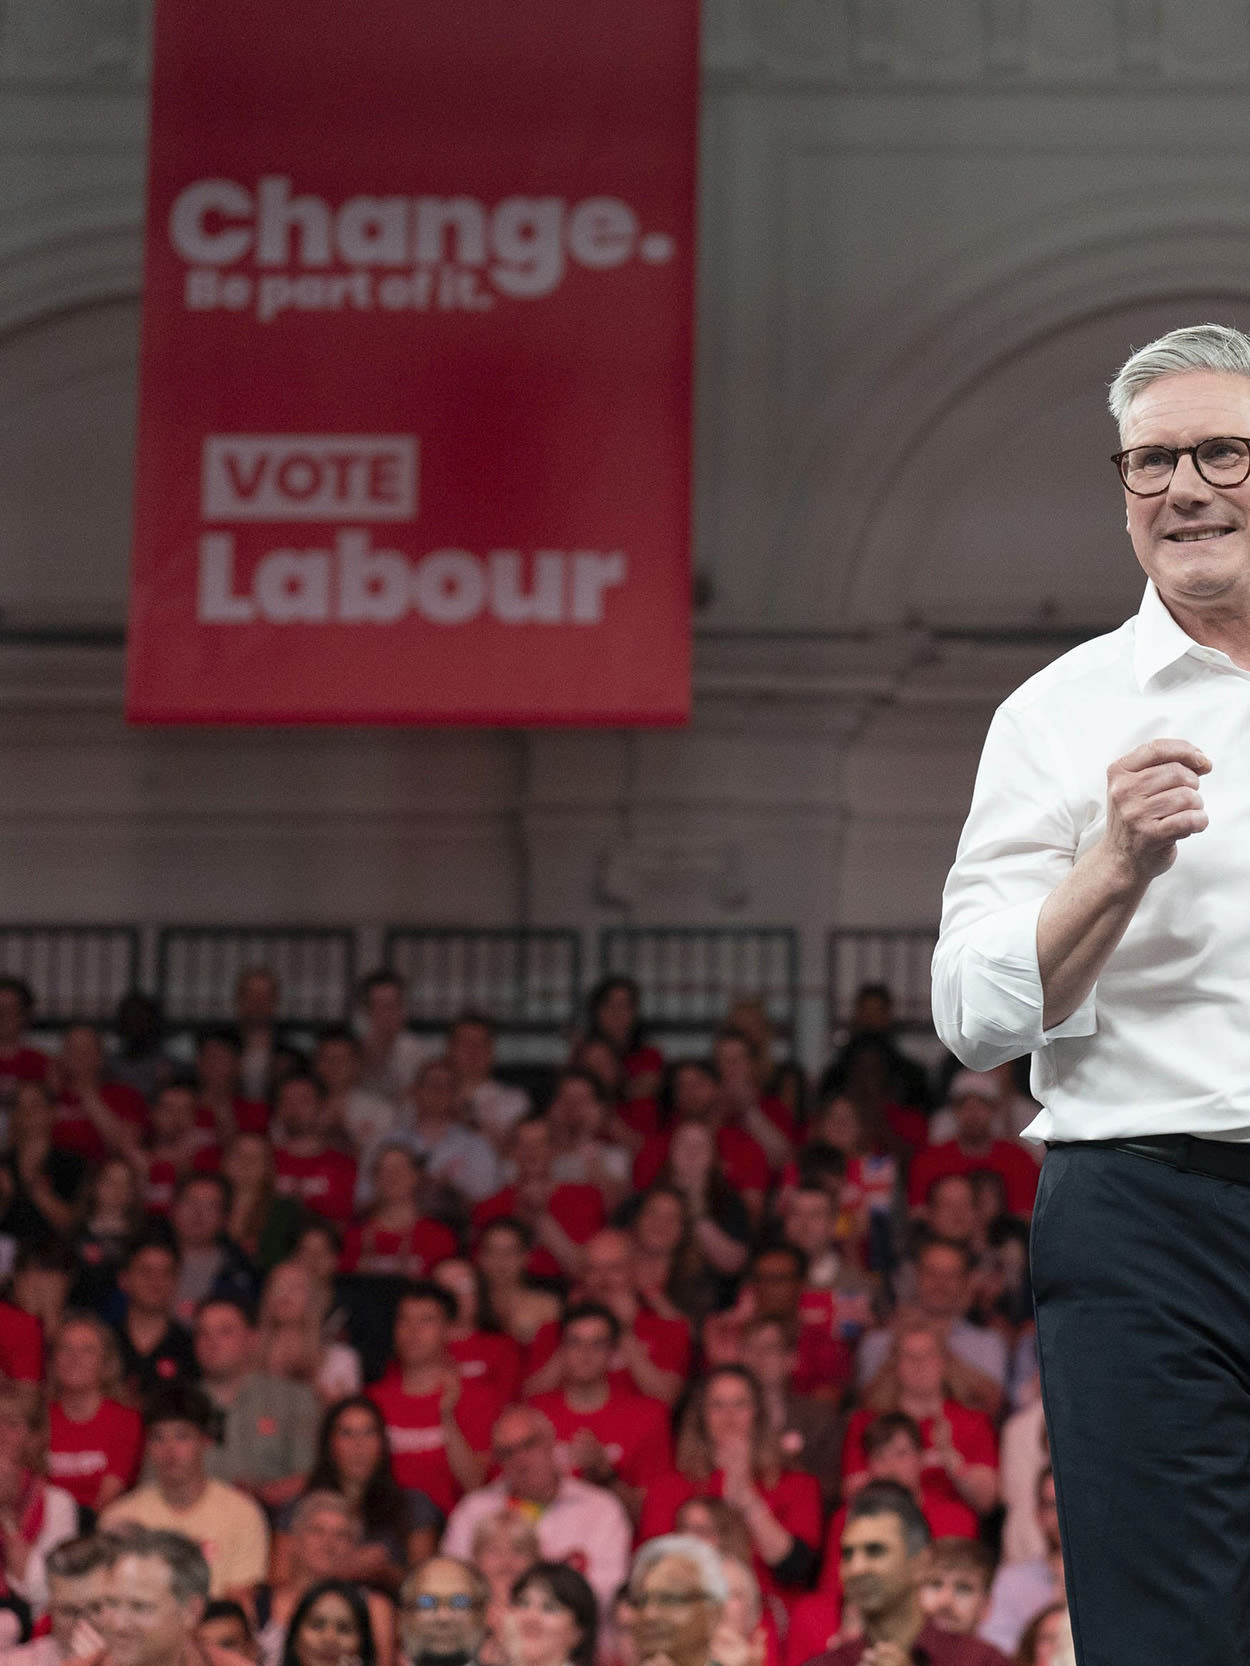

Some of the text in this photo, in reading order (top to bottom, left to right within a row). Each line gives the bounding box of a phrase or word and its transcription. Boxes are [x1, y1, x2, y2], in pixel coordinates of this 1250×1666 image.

[169, 176, 675, 298] Change.
[184, 267, 493, 323] Be part of it.
[224, 453, 401, 502] VOTE
[198, 529, 624, 623] Labour
